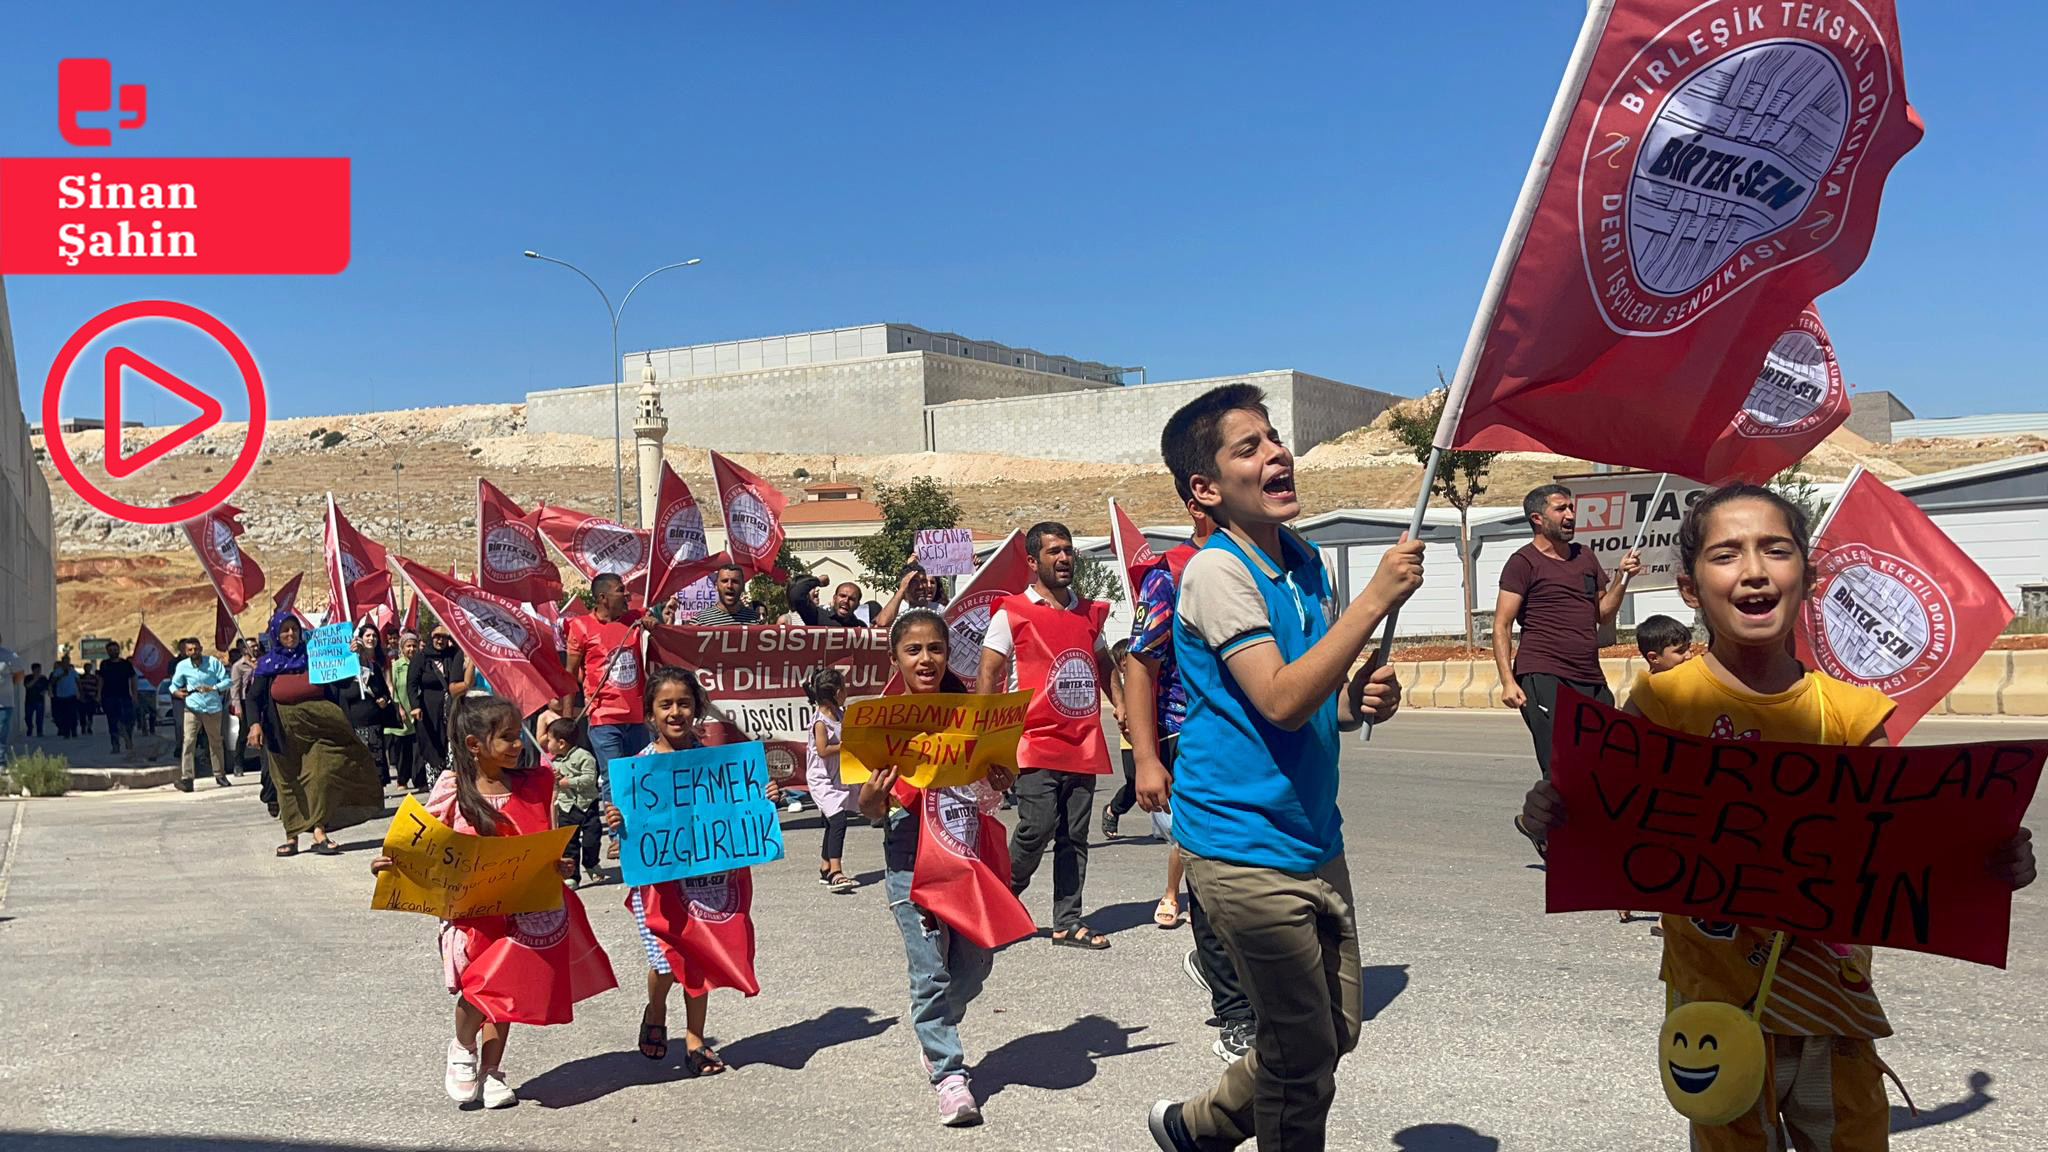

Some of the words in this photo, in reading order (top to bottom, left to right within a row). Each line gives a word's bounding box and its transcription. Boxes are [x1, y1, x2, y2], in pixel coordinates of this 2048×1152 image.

[1619, 5, 1764, 115] BİRLEŞİK
[1781, 1, 1870, 72] TEKSTİL
[1825, 71, 1877, 197] DOKUMA
[1648, 134, 1807, 211] BİRTEK-SEN
[1600, 193, 1624, 264] DERİ
[1663, 238, 1787, 326] SENDİKASI
[1758, 361, 1822, 403] İRTEK-SEN
[697, 625, 748, 653] 7'Lİ
[1833, 585, 1915, 660] BİRTEK-SEN
[1879, 559, 1932, 601] TEKSTİL
[1927, 602, 1946, 662] DOKUMA
[320, 669, 338, 681] VER
[742, 703, 793, 740] İŞÇİSİ
[854, 704, 967, 729] BABAMIN
[673, 759, 762, 808] EKMEK
[1574, 702, 2035, 805] PATRONLAR
[640, 810, 780, 868] ÖZGÜRLÜK
